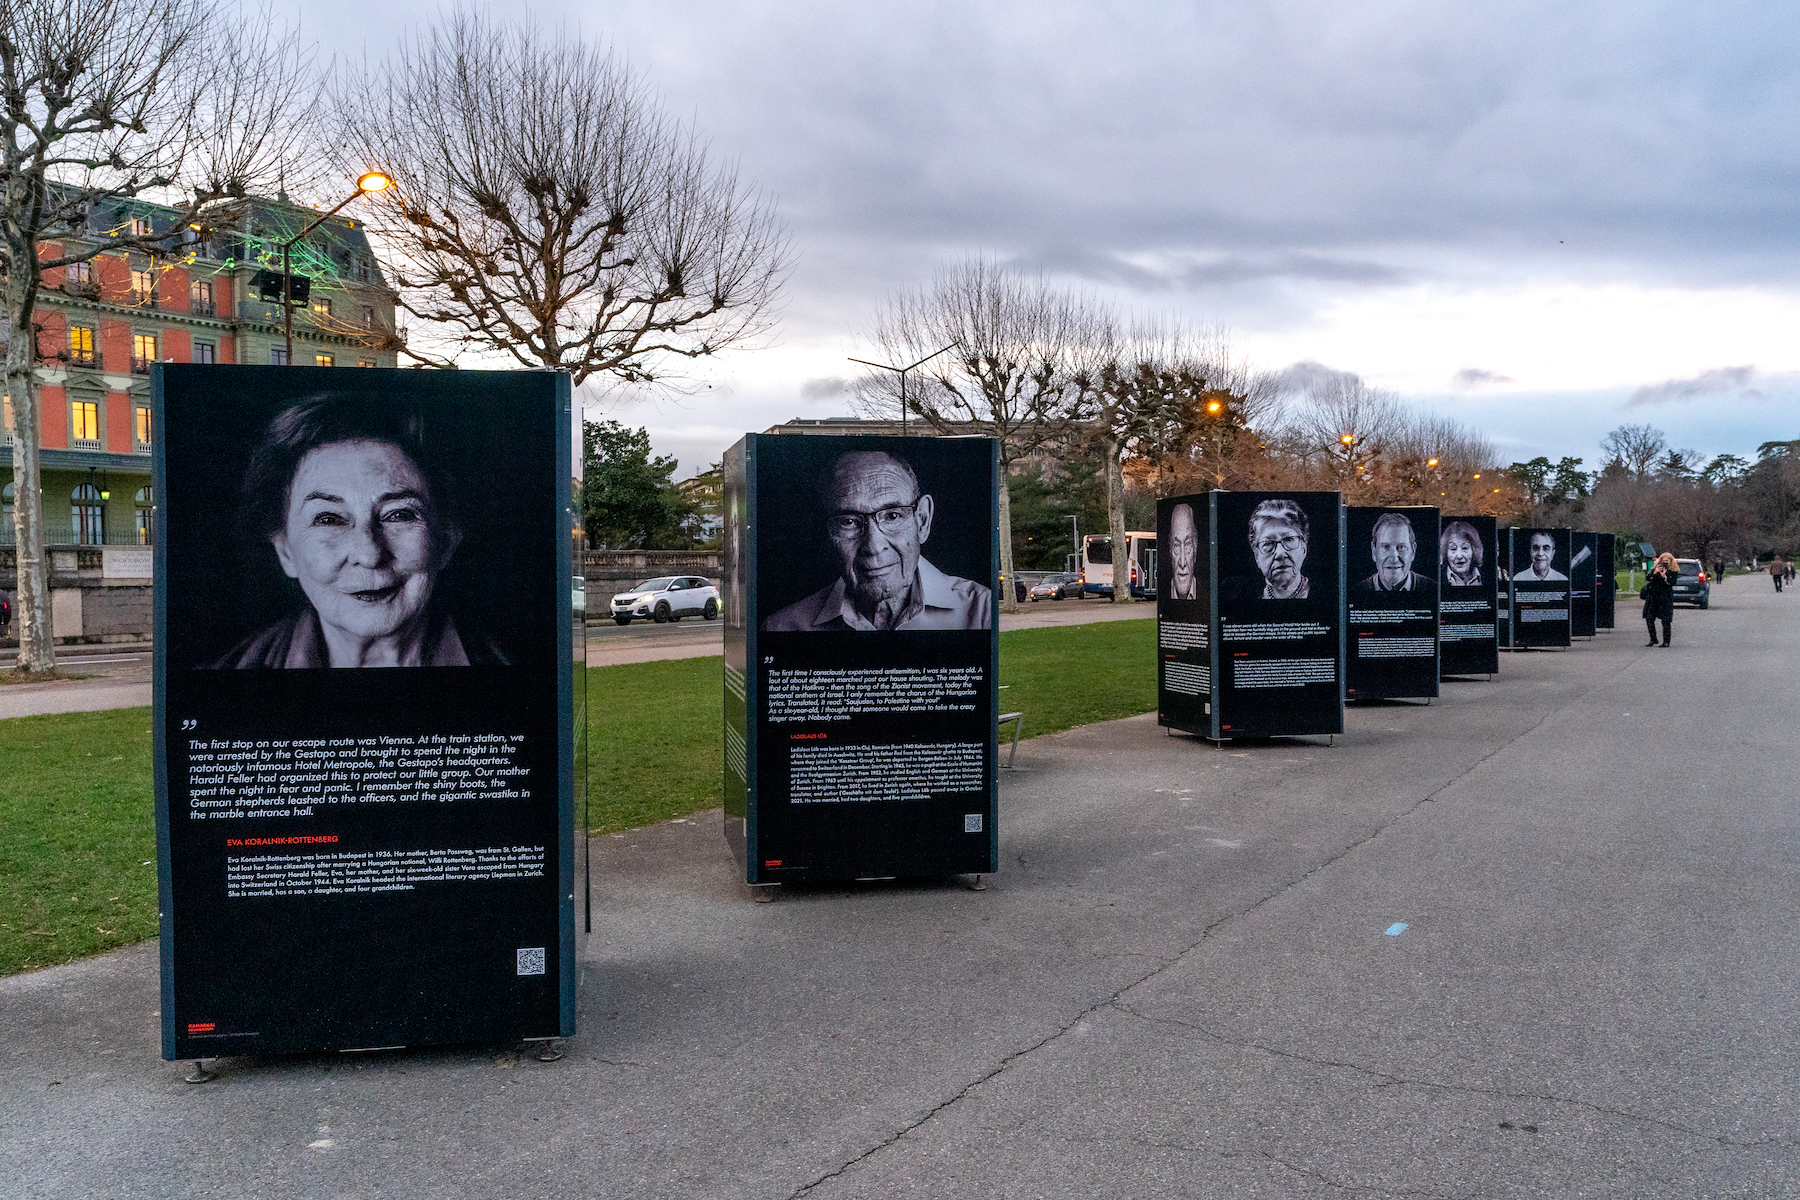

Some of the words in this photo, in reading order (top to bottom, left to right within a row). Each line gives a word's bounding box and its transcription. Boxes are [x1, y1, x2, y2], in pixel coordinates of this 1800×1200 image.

[190, 740, 208, 750] The
[210, 740, 229, 749] first
[232, 739, 253, 750] stop
[292, 740, 326, 749] escape
[329, 737, 354, 746] route
[379, 736, 415, 745] Vienna.
[418, 735, 428, 744] At
[431, 735, 446, 744] the
[449, 734, 471, 744] train
[473, 733, 508, 744] station,
[217, 750, 258, 760] arrested
[260, 750, 273, 761] by
[275, 750, 291, 759] the
[294, 748, 336, 760] Gestapo
[338, 748, 358, 757] and
[360, 747, 398, 758] brought
[401, 747, 411, 756] to
[413, 746, 442, 757] spend
[445, 746, 460, 755] the
[463, 745, 486, 756] night
[489, 745, 498, 754] in
[501, 744, 516, 754] the
[189, 762, 244, 774] notoriously
[246, 761, 292, 771] infamous
[294, 760, 321, 770] Hotel
[323, 759, 376, 771] Metropole,
[379, 759, 394, 768] the
[446, 756, 511, 768] headquarters.
[189, 774, 224, 784] Harald
[227, 774, 254, 783] Feller
[257, 773, 277, 782] had
[279, 772, 328, 784] organized
[331, 771, 348, 781] this
[350, 771, 361, 780] to
[362, 770, 396, 782] protect
[418, 769, 438, 778] little
[440, 771, 472, 780] group.
[474, 768, 494, 777] Our
[496, 767, 530, 776] mother
[190, 786, 217, 798] spent
[219, 786, 236, 795] the
[238, 785, 264, 796] night
[266, 785, 276, 794] in
[279, 784, 299, 793] fear
[302, 783, 321, 793] and
[323, 782, 354, 794] panic.
[356, 782, 360, 791] I
[362, 781, 412, 791] remember
[414, 780, 430, 790] the
[432, 780, 457, 791] shiny
[459, 779, 488, 789] boots,
[490, 778, 506, 788] the
[190, 797, 232, 807] German
[235, 796, 285, 808] shepherds
[287, 795, 325, 805] leashed
[328, 794, 338, 804] to
[340, 794, 356, 803] the
[359, 793, 397, 804] officers,
[400, 792, 419, 802] and
[421, 792, 437, 801] the
[439, 790, 477, 802] gigantic
[479, 789, 518, 799] swastika
[521, 789, 530, 798] in
[190, 810, 206, 819] the
[209, 809, 244, 819] marble
[247, 807, 290, 818] entrance
[293, 807, 314, 816] hall.
[245, 836, 338, 845] KORALNIK-ROTTENBERG
[283, 862, 315, 870] citizenship
[333, 860, 360, 869] marrying
[368, 859, 399, 867] Hungarian
[339, 852, 366, 860] Budapest
